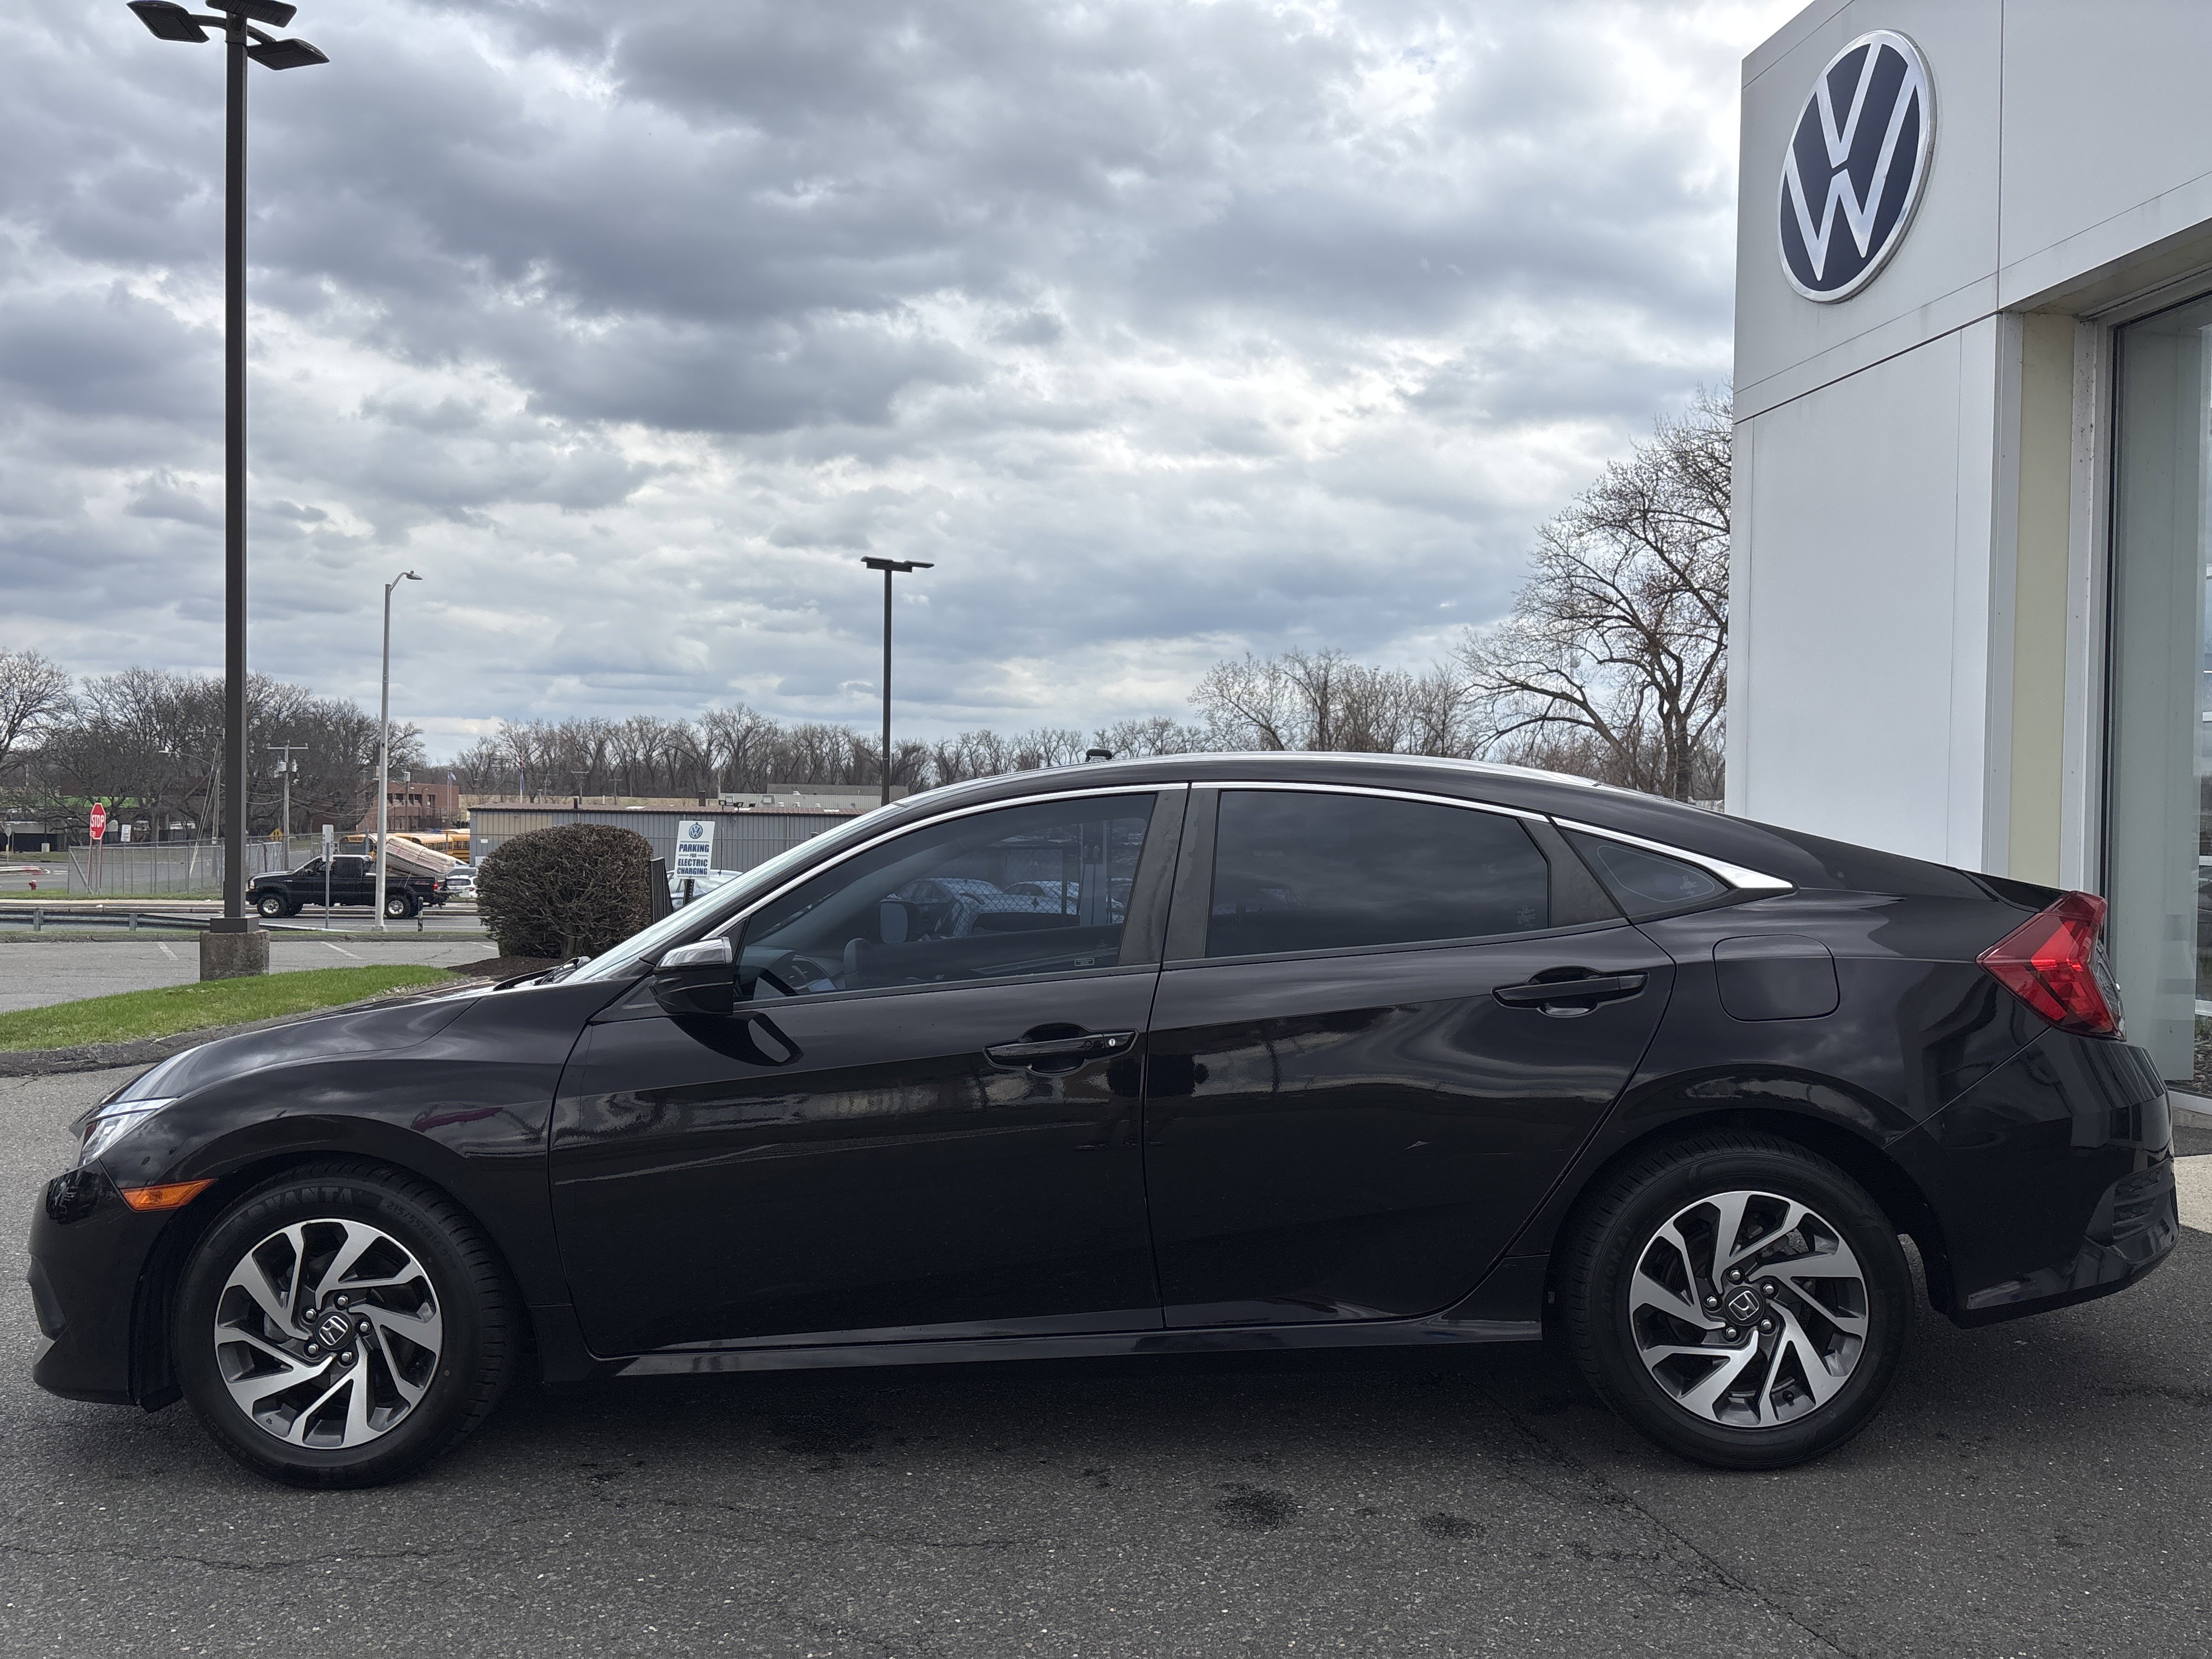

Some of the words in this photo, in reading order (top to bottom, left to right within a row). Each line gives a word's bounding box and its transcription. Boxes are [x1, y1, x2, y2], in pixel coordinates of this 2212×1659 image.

[1785, 43, 1916, 281] VW
[91, 814, 104, 828] STOP
[679, 844, 709, 853] PARKING
[678, 859, 708, 867] ELECTRIC
